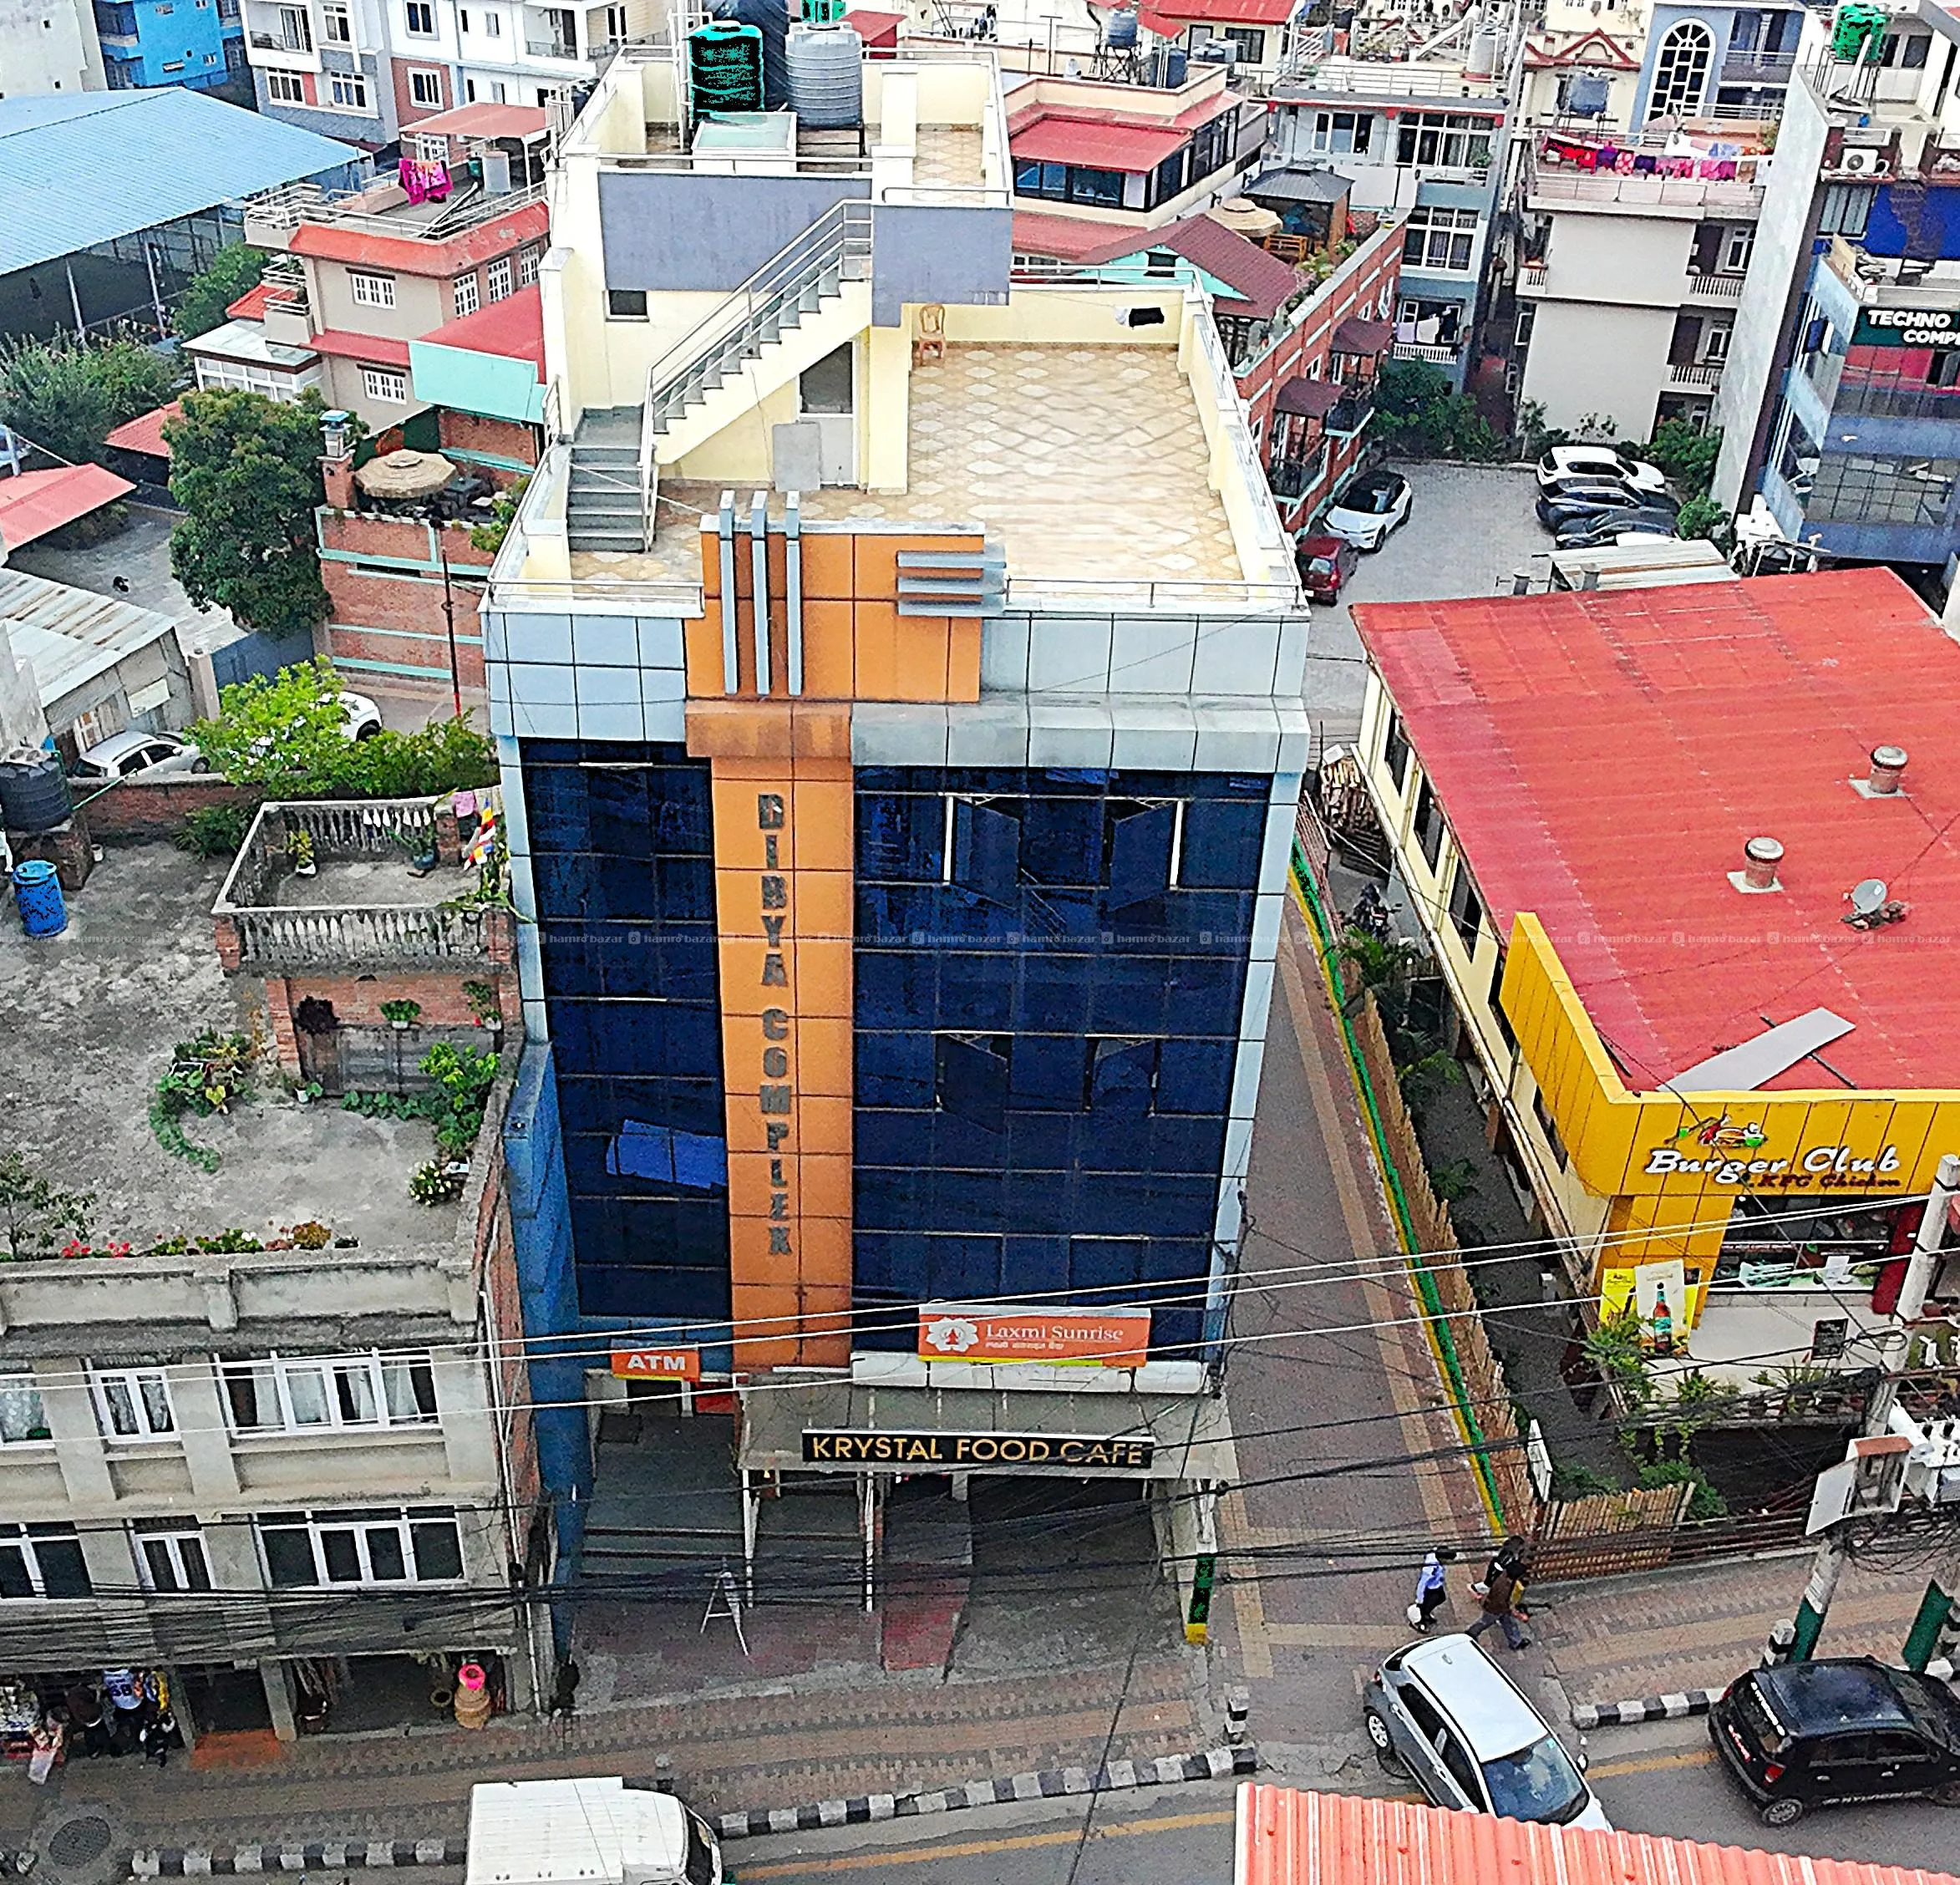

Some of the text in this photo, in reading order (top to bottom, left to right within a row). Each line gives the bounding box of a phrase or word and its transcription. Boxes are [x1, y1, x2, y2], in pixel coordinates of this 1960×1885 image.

[1868, 310, 1952, 328] TECHNO
[759, 794, 789, 987] DIBYA
[759, 1009, 792, 1255] COMPLEX
[1645, 1148, 1788, 1184] Burger
[1803, 1145, 1900, 1173] Club
[987, 1324, 1124, 1340] Laxmi Sunrise
[627, 1354, 686, 1370] ATM
[812, 1436, 1144, 1465] KRYSTAL FOOD CAFE
